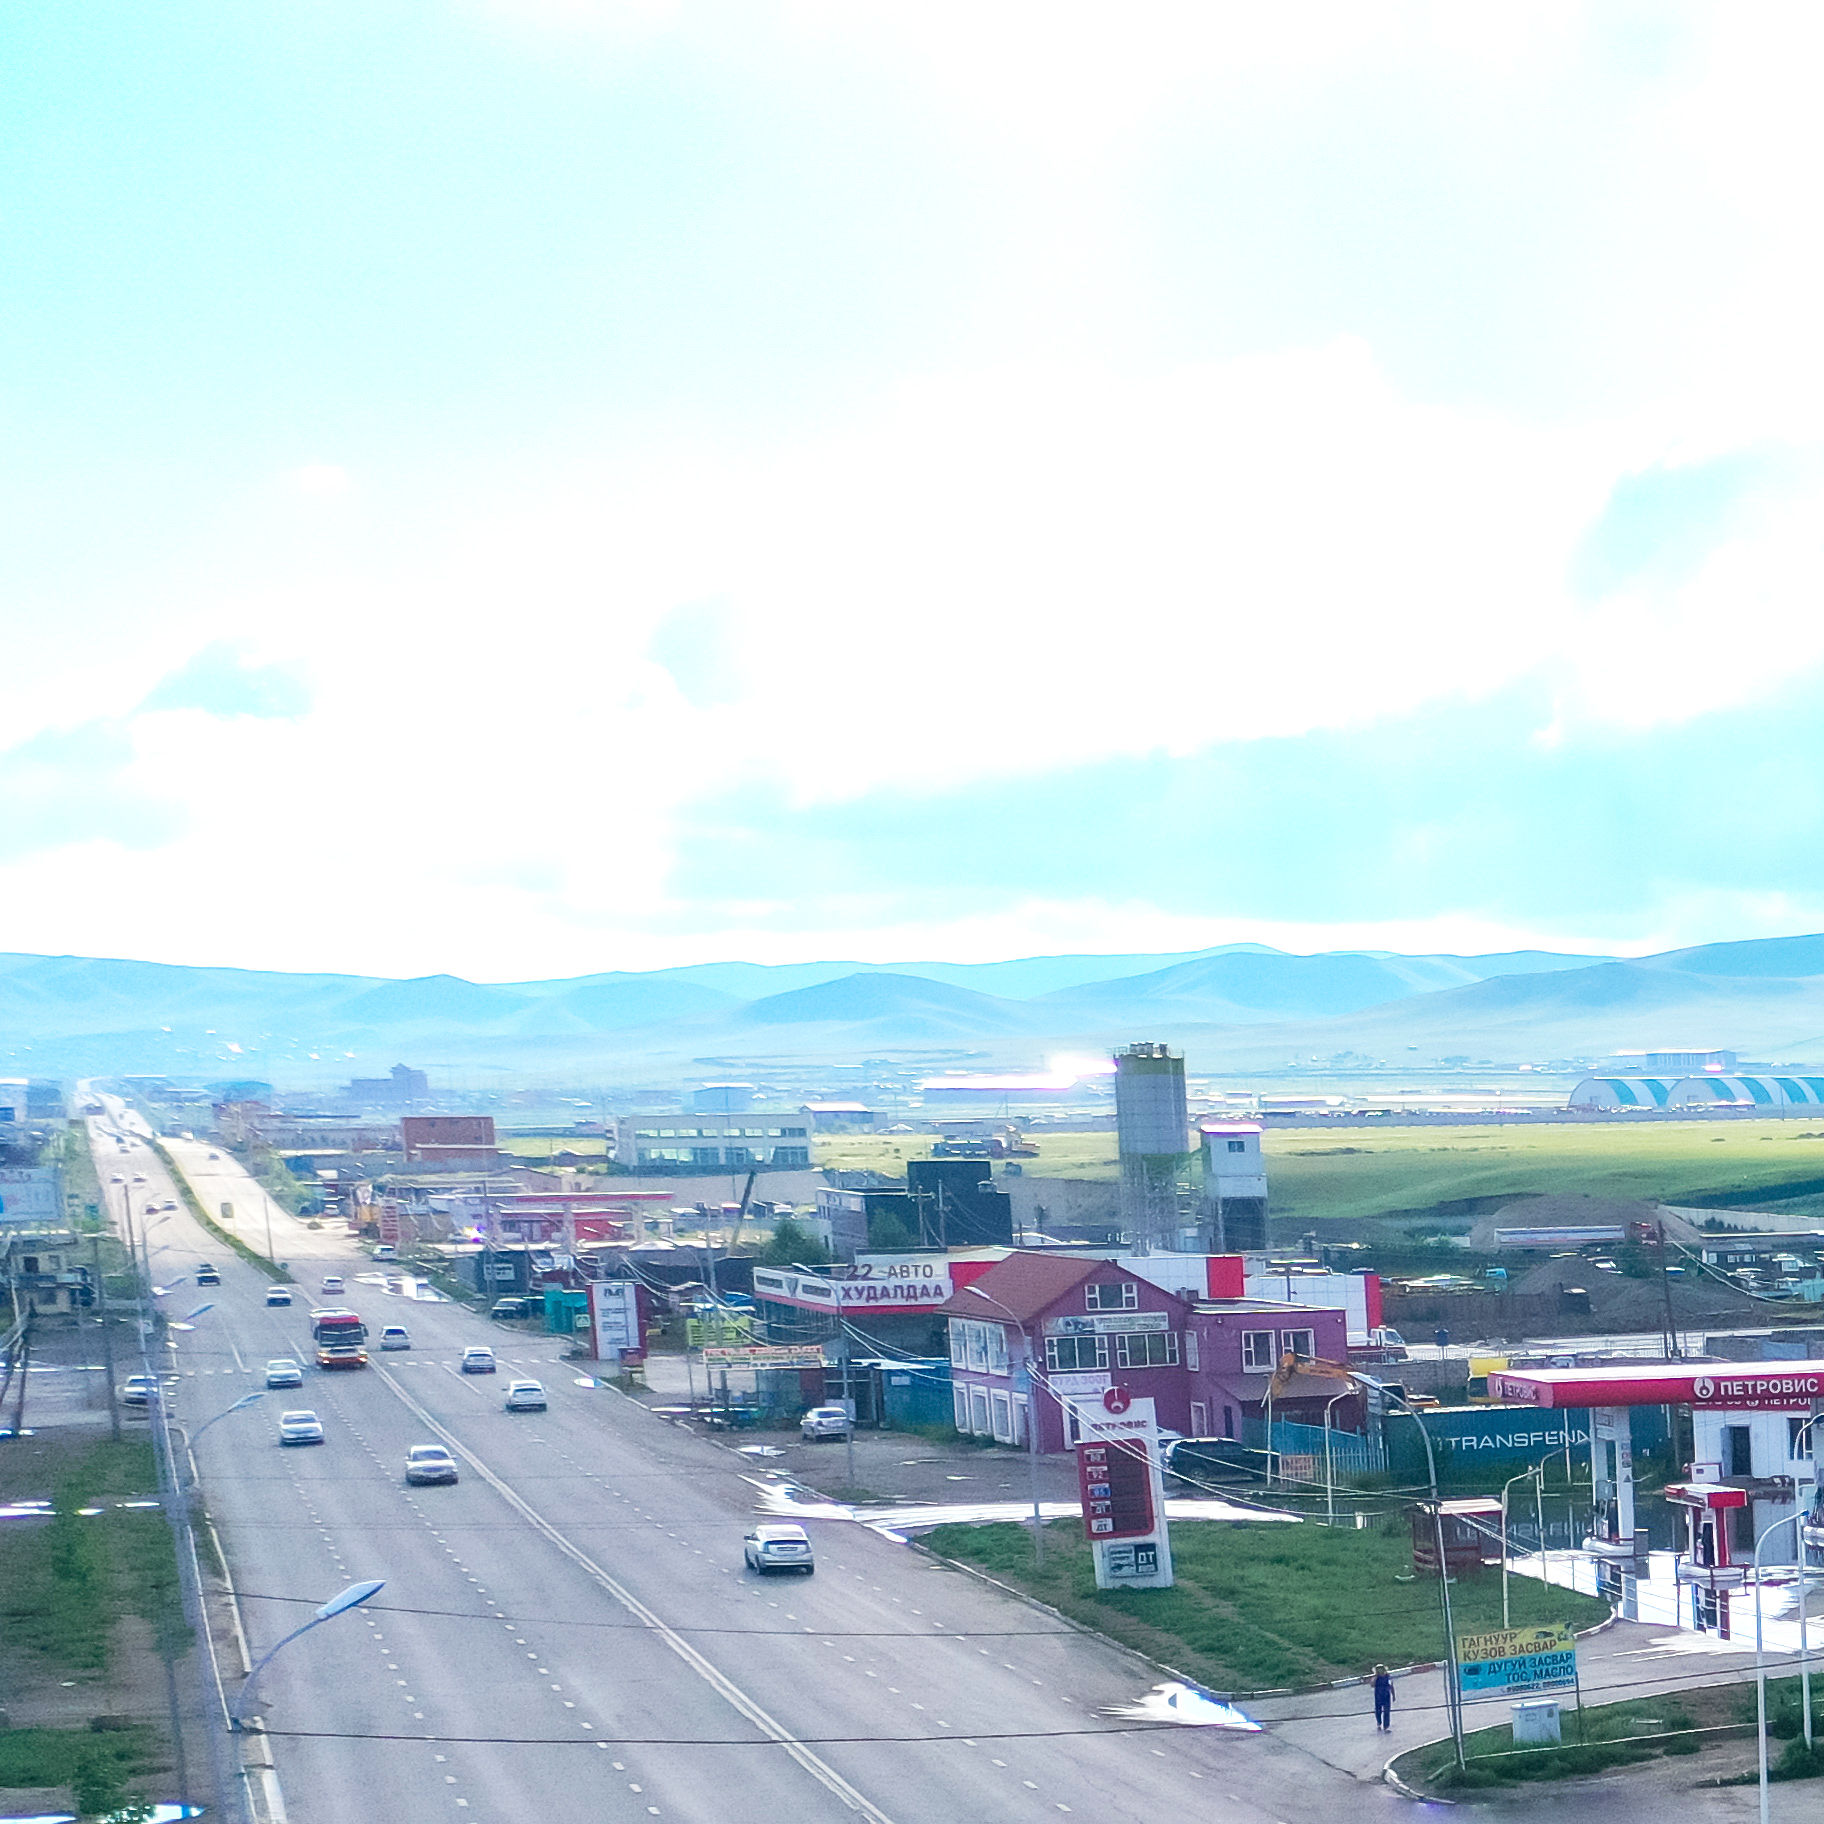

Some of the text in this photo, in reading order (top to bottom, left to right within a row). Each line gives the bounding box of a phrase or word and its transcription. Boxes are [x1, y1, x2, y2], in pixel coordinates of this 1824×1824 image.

[888, 1264, 933, 1279] АВТО
[841, 1284, 945, 1303] ХУДАЛДАА
[1720, 1378, 1819, 1396] ПЕТРОВИС
[1462, 1632, 1517, 1648] ГАГНУУР
[1463, 1639, 1557, 1661] КУЗОВ ЗАСВАР
[1488, 1652, 1573, 1675] ДУГУЙ ЗАСВАР
[1533, 1665, 1574, 1679] МАСЛО
